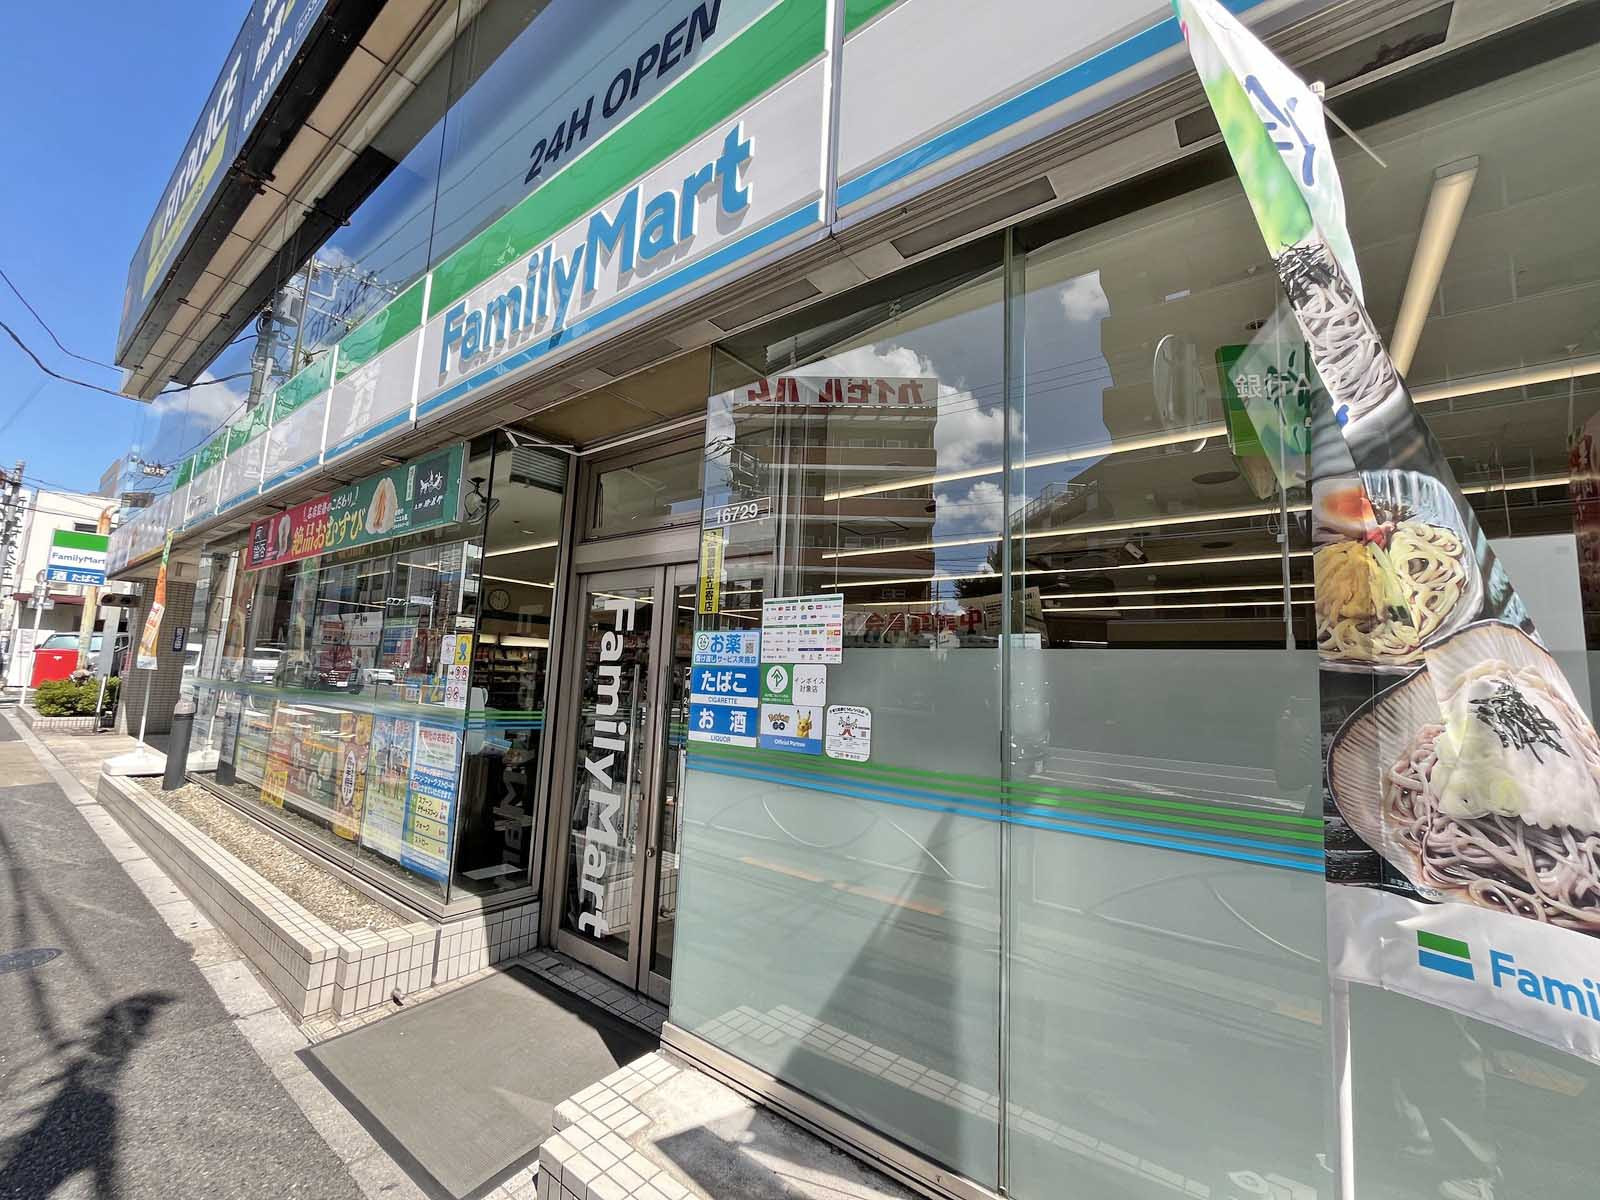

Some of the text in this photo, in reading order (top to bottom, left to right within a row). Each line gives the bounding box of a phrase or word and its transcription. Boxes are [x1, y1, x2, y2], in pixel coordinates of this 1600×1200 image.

[524, 0, 722, 184] 24H OPEN
[440, 121, 754, 384] FamilyMart
[716, 503, 758, 524] 16729
[52, 552, 105, 564] FamilyMart
[52, 570, 101, 584] 酒 たばこ
[711, 634, 740, 654] お薬
[701, 671, 747, 692] たばこ
[794, 677, 825, 686] インボイス
[800, 685, 818, 693] 対象店
[699, 708, 747, 733] お酒
[772, 722, 785, 730] GO
[711, 735, 731, 743] LIQUOR
[578, 599, 636, 938] FamilyMart
[1490, 949, 1600, 1021] Fami
